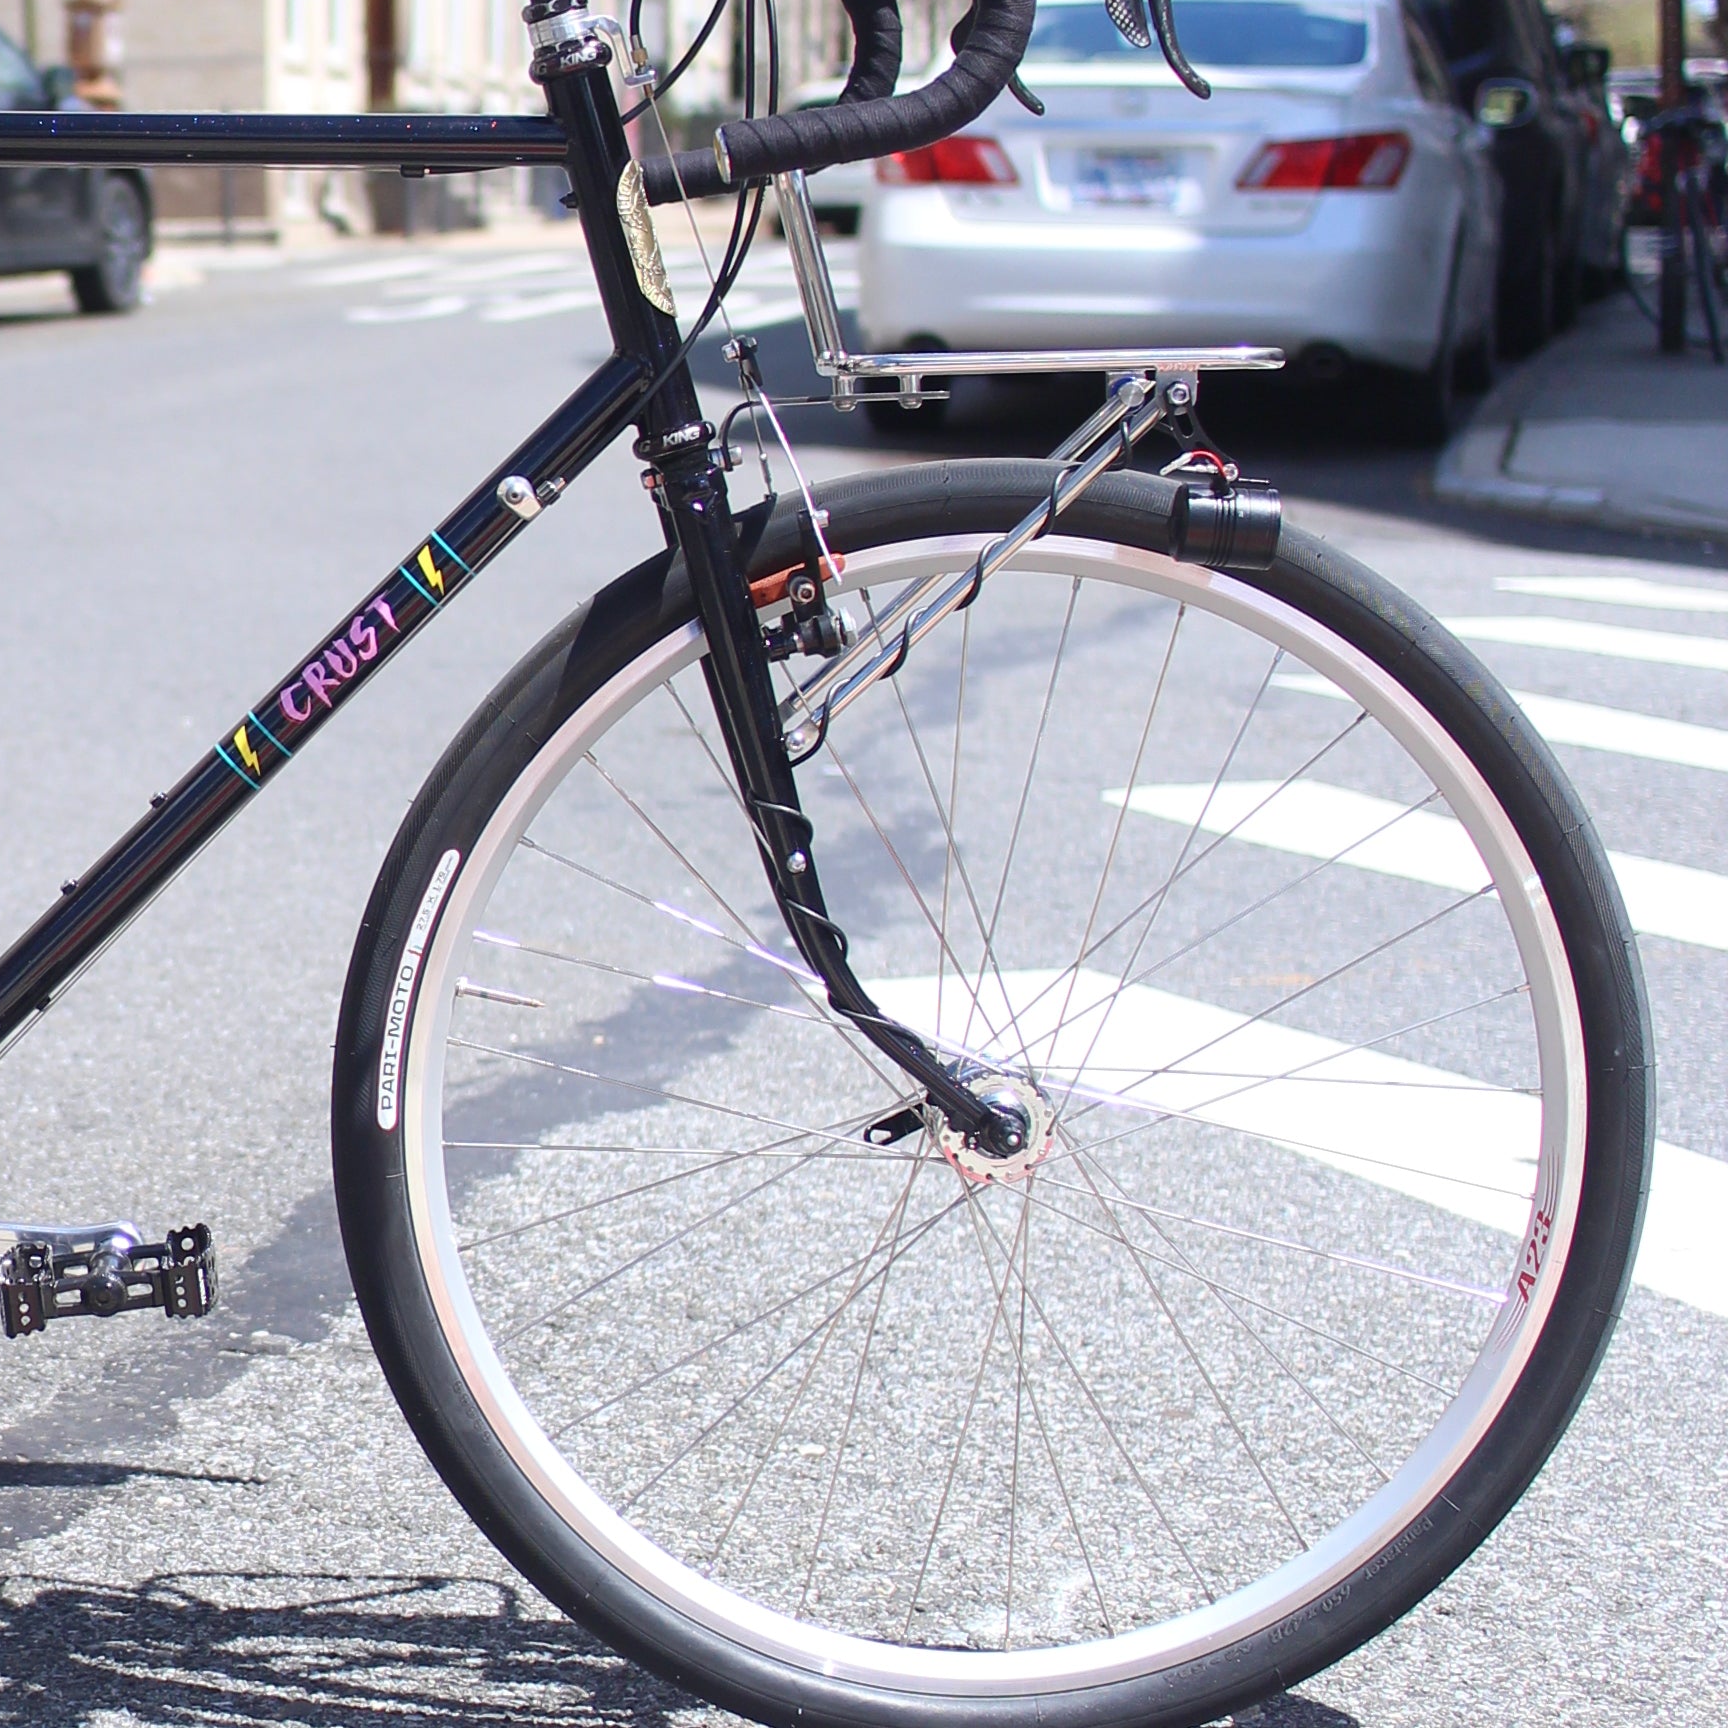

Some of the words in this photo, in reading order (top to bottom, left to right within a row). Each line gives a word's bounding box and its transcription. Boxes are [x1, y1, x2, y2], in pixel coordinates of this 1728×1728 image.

[560, 47, 597, 69] KING
[662, 425, 701, 448] KING
[279, 589, 401, 722] CRUST
[380, 964, 414, 1111] PARI-MOTO
[1516, 1209, 1552, 1304] A23
